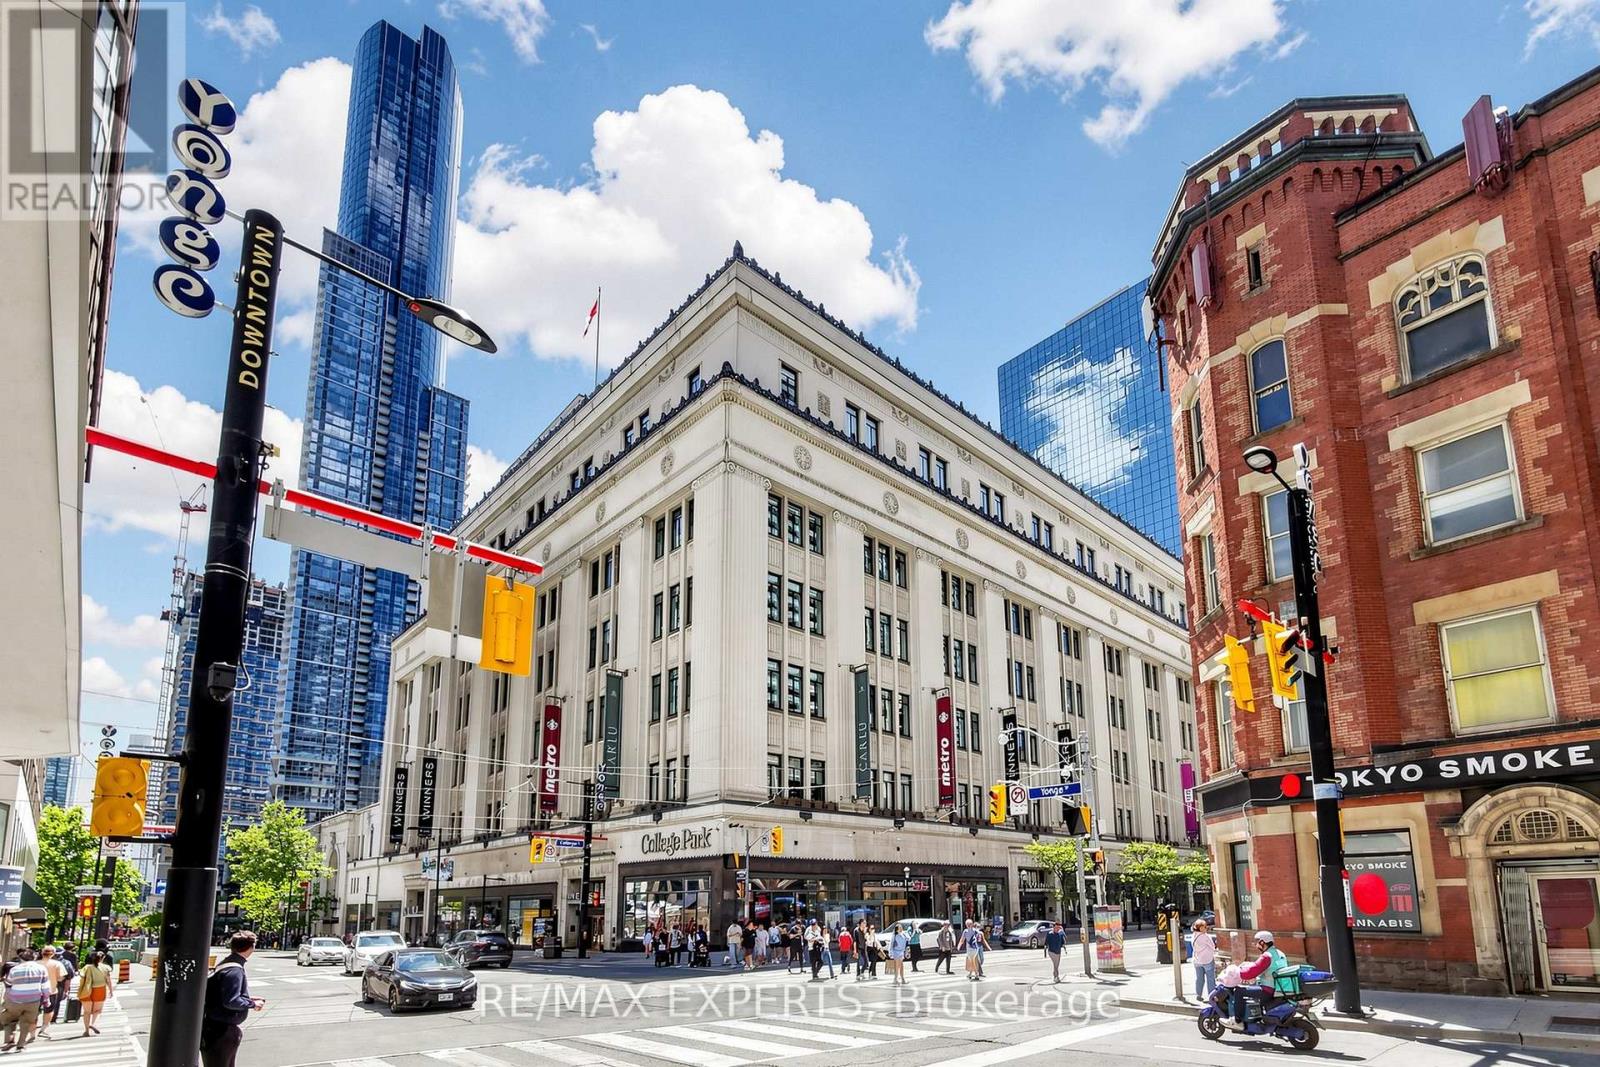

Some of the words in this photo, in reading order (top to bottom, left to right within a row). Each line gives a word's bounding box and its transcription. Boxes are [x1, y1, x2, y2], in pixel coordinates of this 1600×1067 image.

[238, 225, 275, 390] DOWNTOWN
[545, 744, 557, 793] metro
[858, 722, 868, 772] CARLU
[940, 737, 951, 787] metro
[1006, 722, 1016, 779] INNERS
[1306, 763, 1423, 788] KYO
[1439, 745, 1594, 778] SMOKE
[392, 773, 405, 827] WINNERS
[421, 762, 435, 820] WINNERS
[641, 832, 681, 856] College
[681, 827, 712, 850] Park
[1352, 919, 1413, 928] NNABIS
